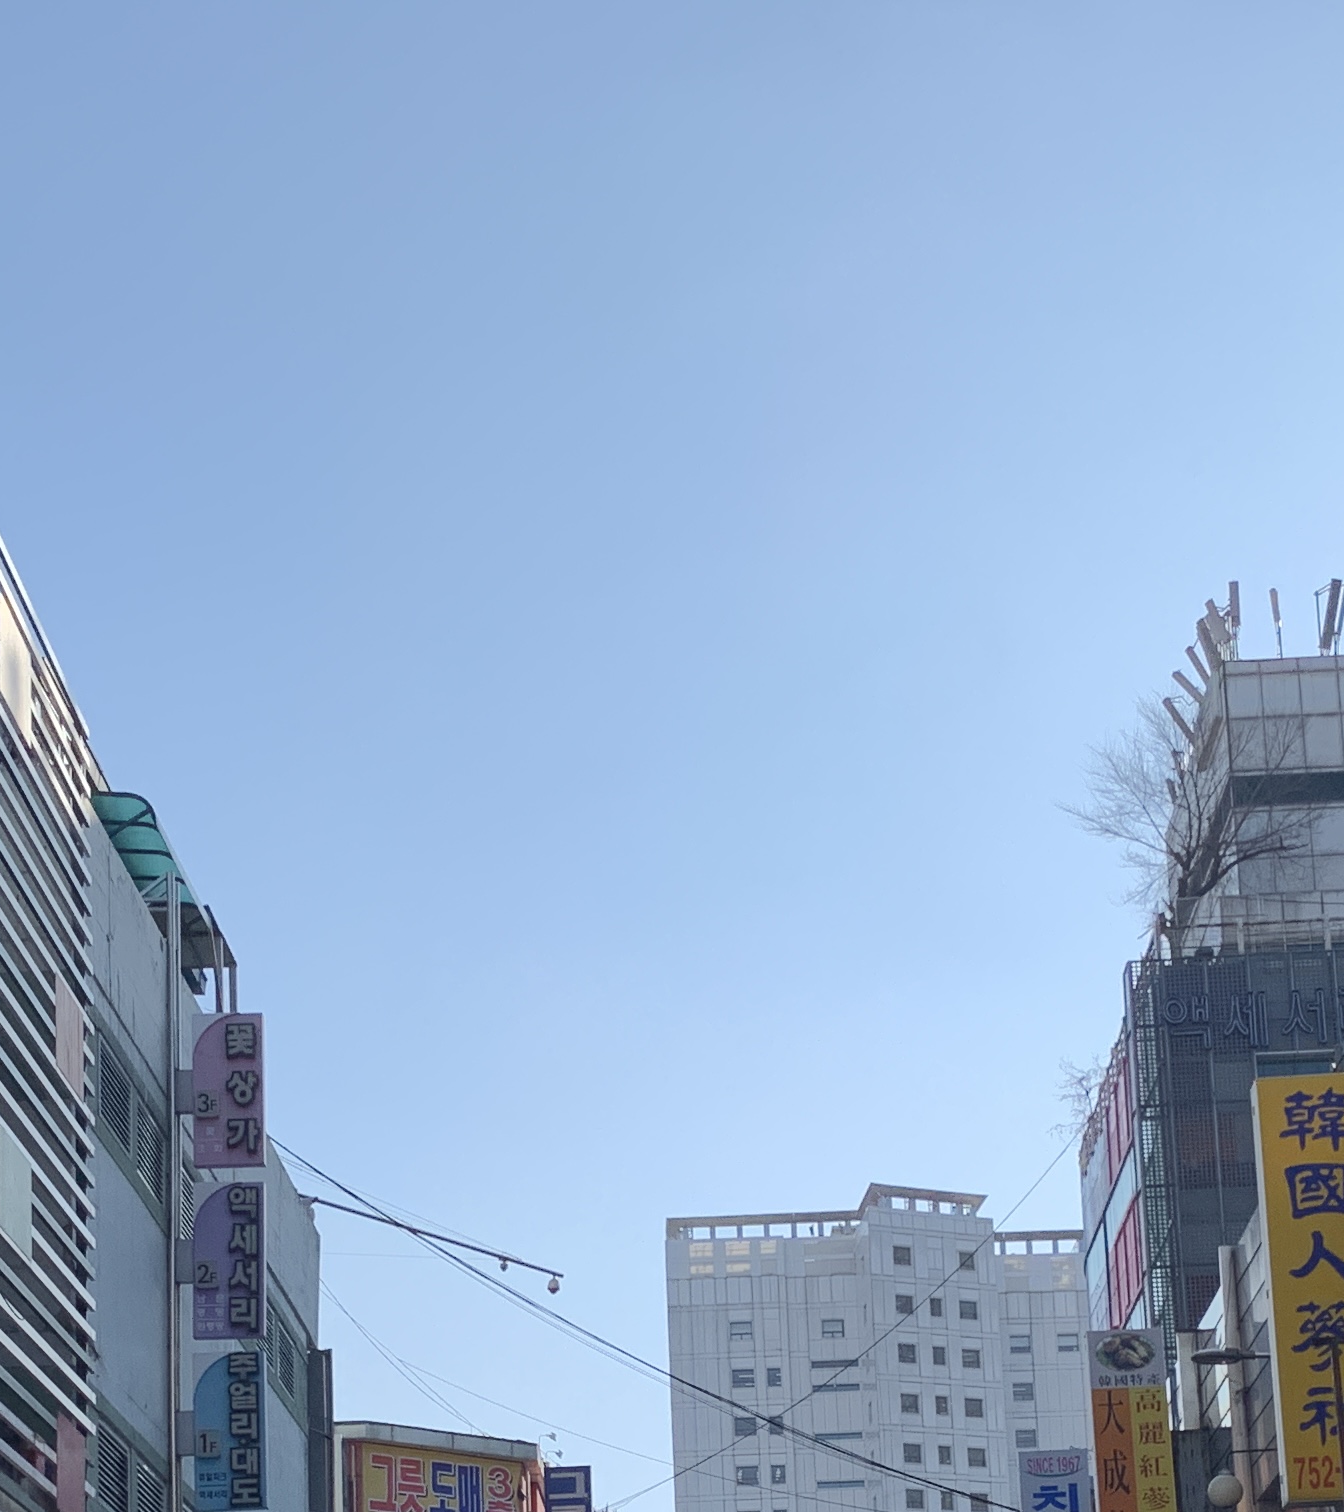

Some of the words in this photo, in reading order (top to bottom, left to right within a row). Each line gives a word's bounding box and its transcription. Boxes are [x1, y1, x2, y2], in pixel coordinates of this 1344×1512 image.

[228, 1187, 258, 1332] 액세서리
[1027, 1457, 1054, 1474] SINCE
[1056, 1455, 1081, 1472] 1967
